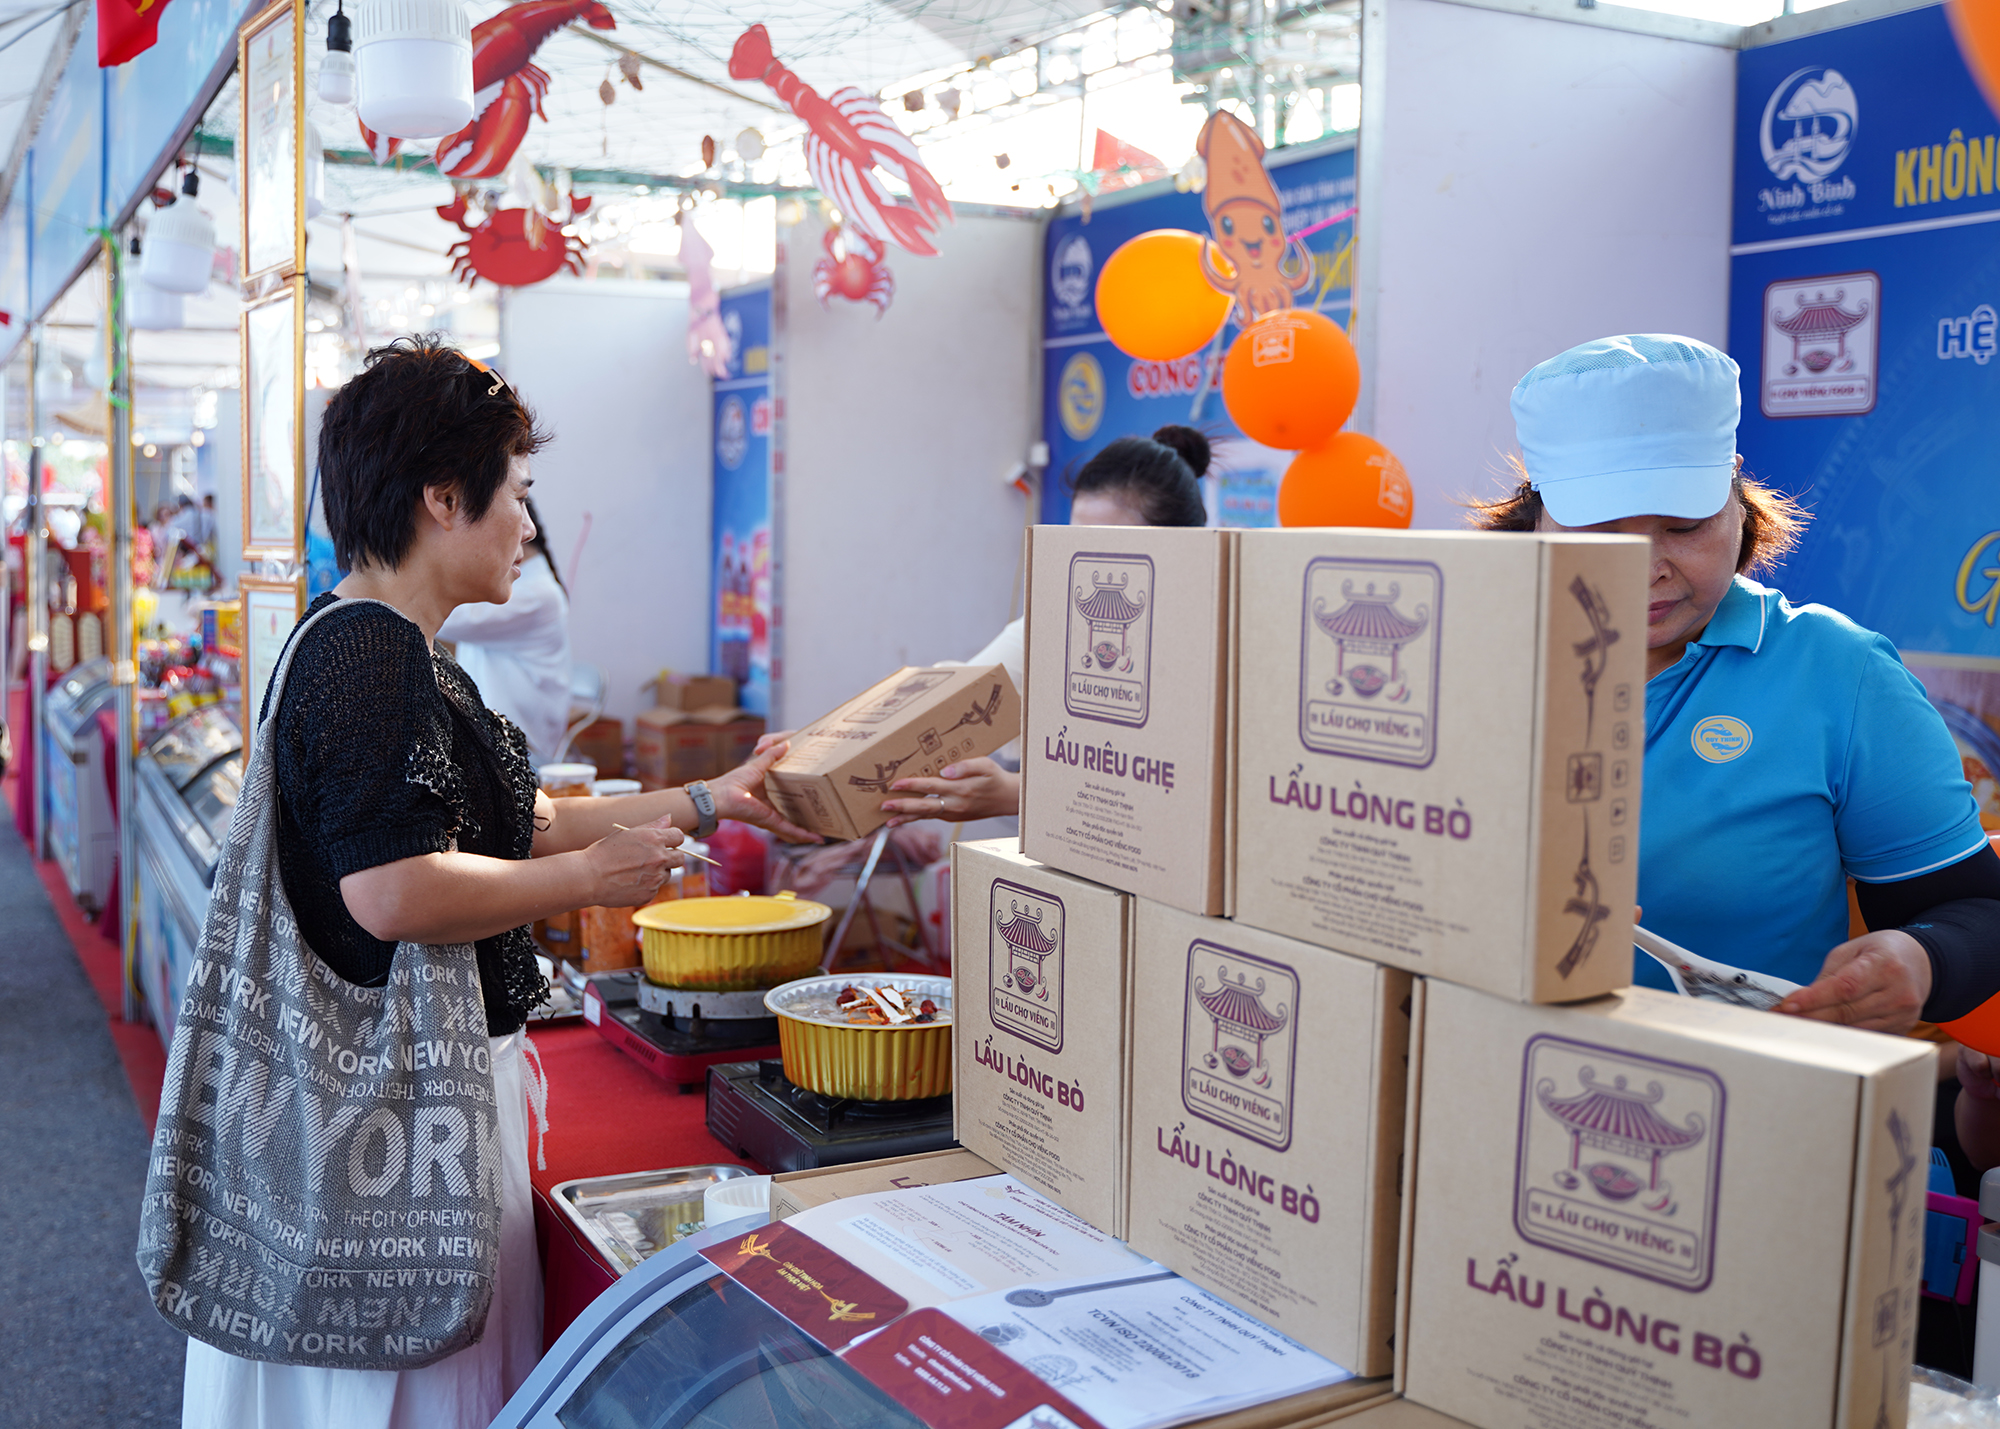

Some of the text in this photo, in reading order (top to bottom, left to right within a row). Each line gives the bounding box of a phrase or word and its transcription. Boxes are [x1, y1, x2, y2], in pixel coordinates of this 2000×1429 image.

[1894, 127, 2000, 208] KHÔN
[1937, 304, 1998, 366] HỆ
[1045, 725, 1175, 794] LẨU RIÊU GHẸ
[1269, 763, 1322, 812] LẨU
[1330, 780, 1416, 830] LÒNG
[1423, 797, 1472, 841] BÒ
[303, 951, 340, 990] NEW
[413, 963, 459, 986] YORK
[277, 1003, 325, 1050] NEW
[326, 1038, 395, 1076] YORK
[400, 1040, 491, 1075] NEW YO
[974, 1034, 1004, 1074] LẨU
[1007, 1054, 1054, 1100] LÒNG
[1057, 1078, 1085, 1113] BÒ
[301, 1084, 504, 1208] YORK
[1157, 1121, 1201, 1169] LẨU
[1206, 1148, 1275, 1205] LÒNG
[1281, 1183, 1321, 1224] BÒ
[177, 1162, 219, 1198] YORK
[222, 1189, 263, 1222] NEW
[315, 1236, 364, 1259] NEW
[369, 1236, 427, 1259] YORK
[438, 1235, 484, 1259] NEW
[366, 1270, 419, 1289] NEW
[1180, 1295, 1208, 1312] CÔNG
[1203, 1307, 1219, 1318] TY
[208, 1303, 276, 1348] NEW
[283, 1331, 370, 1356] YORK
[1086, 1307, 1121, 1330] TCVN
[1113, 1326, 1140, 1341] ISO
[1466, 1252, 1762, 1381] LẨU LÒNG BÒ
